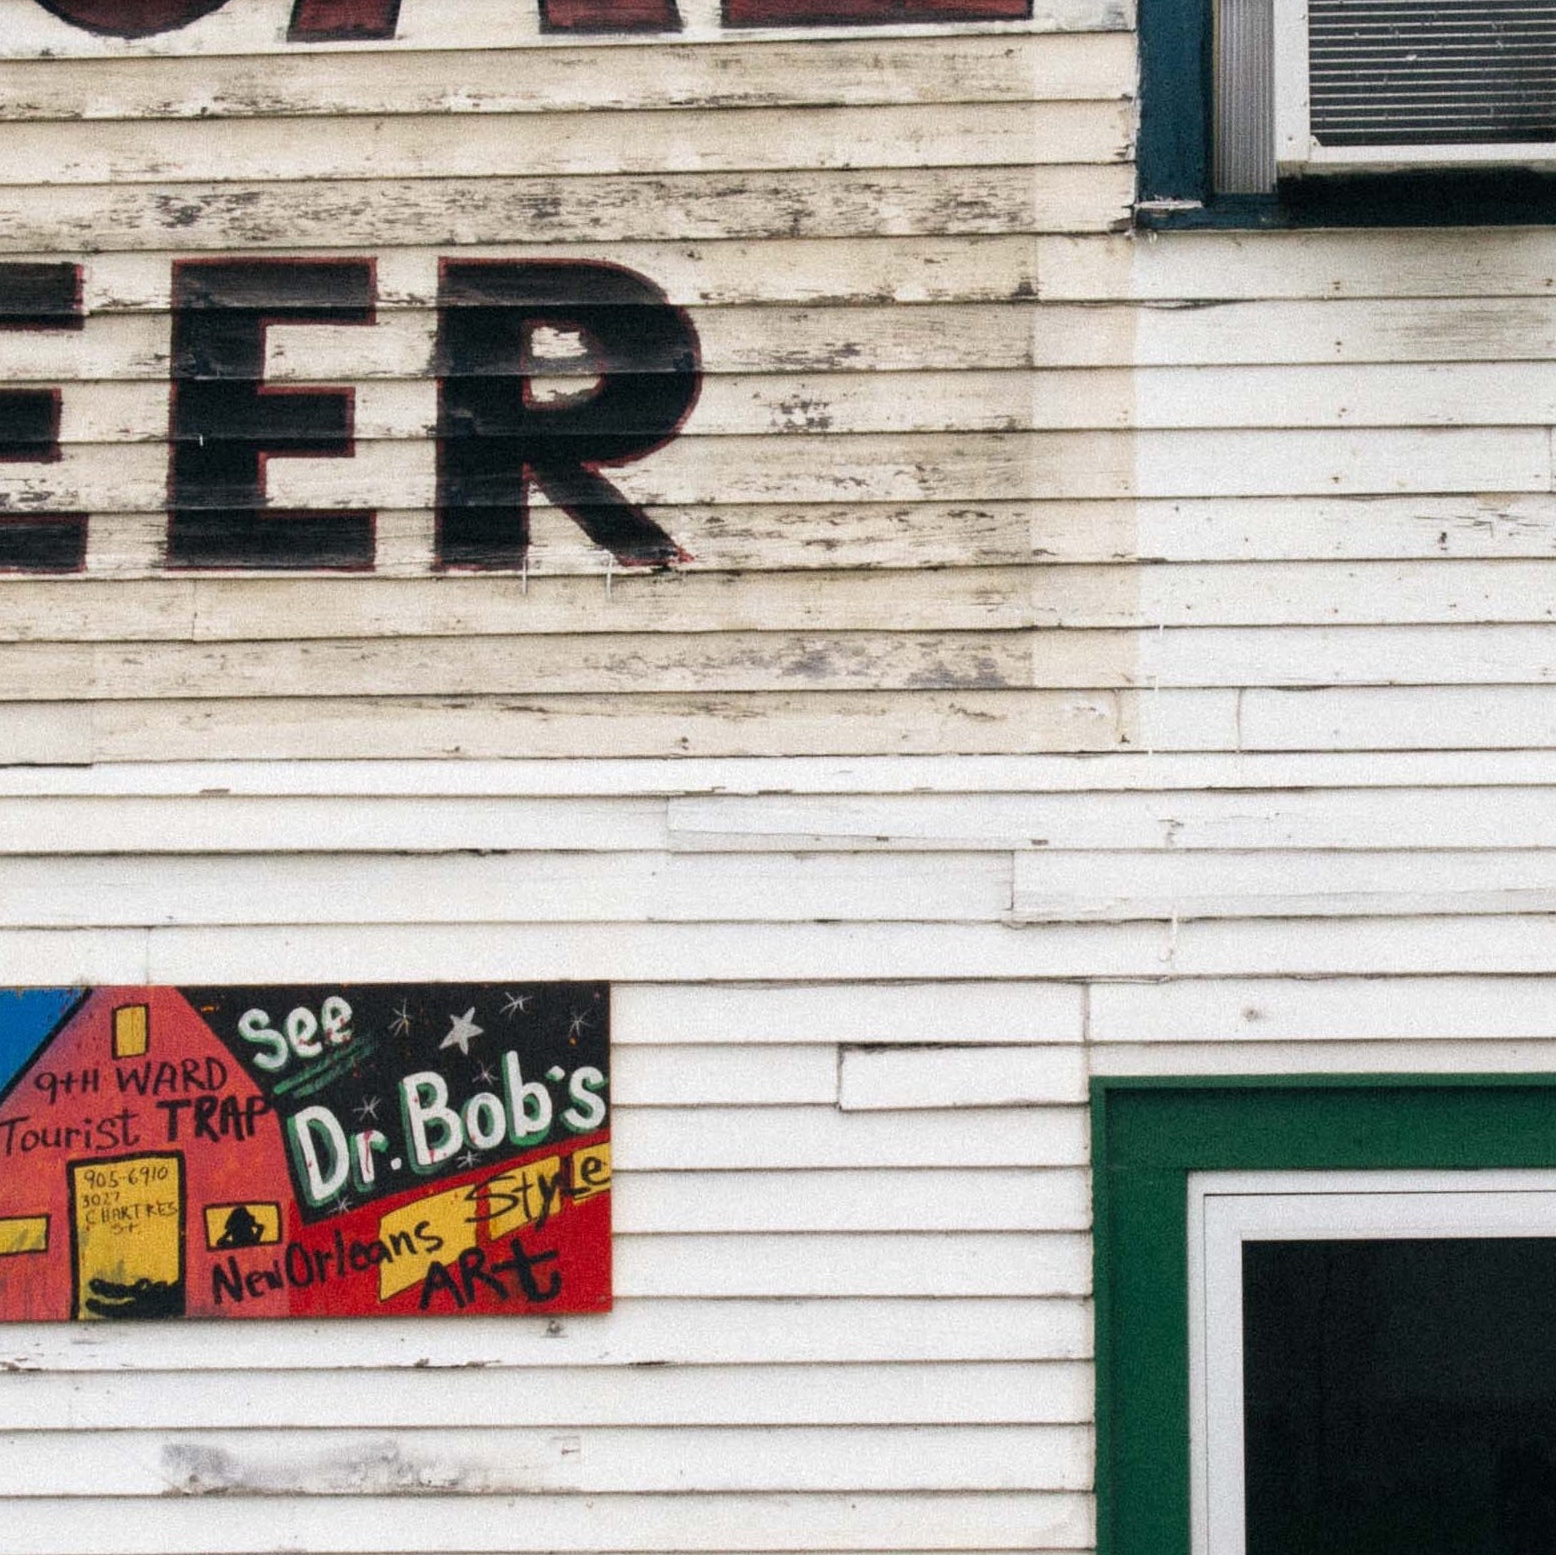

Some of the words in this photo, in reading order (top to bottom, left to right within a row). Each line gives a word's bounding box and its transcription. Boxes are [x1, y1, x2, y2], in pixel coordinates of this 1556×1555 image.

[238, 995, 353, 1072] See
[115, 1056, 228, 1096] WARD
[156, 1095, 273, 1144] TRAP
[287, 1105, 402, 1208] Dr.
[399, 1050, 608, 1176] Bob's
[285, 1221, 444, 1289] Orleans
